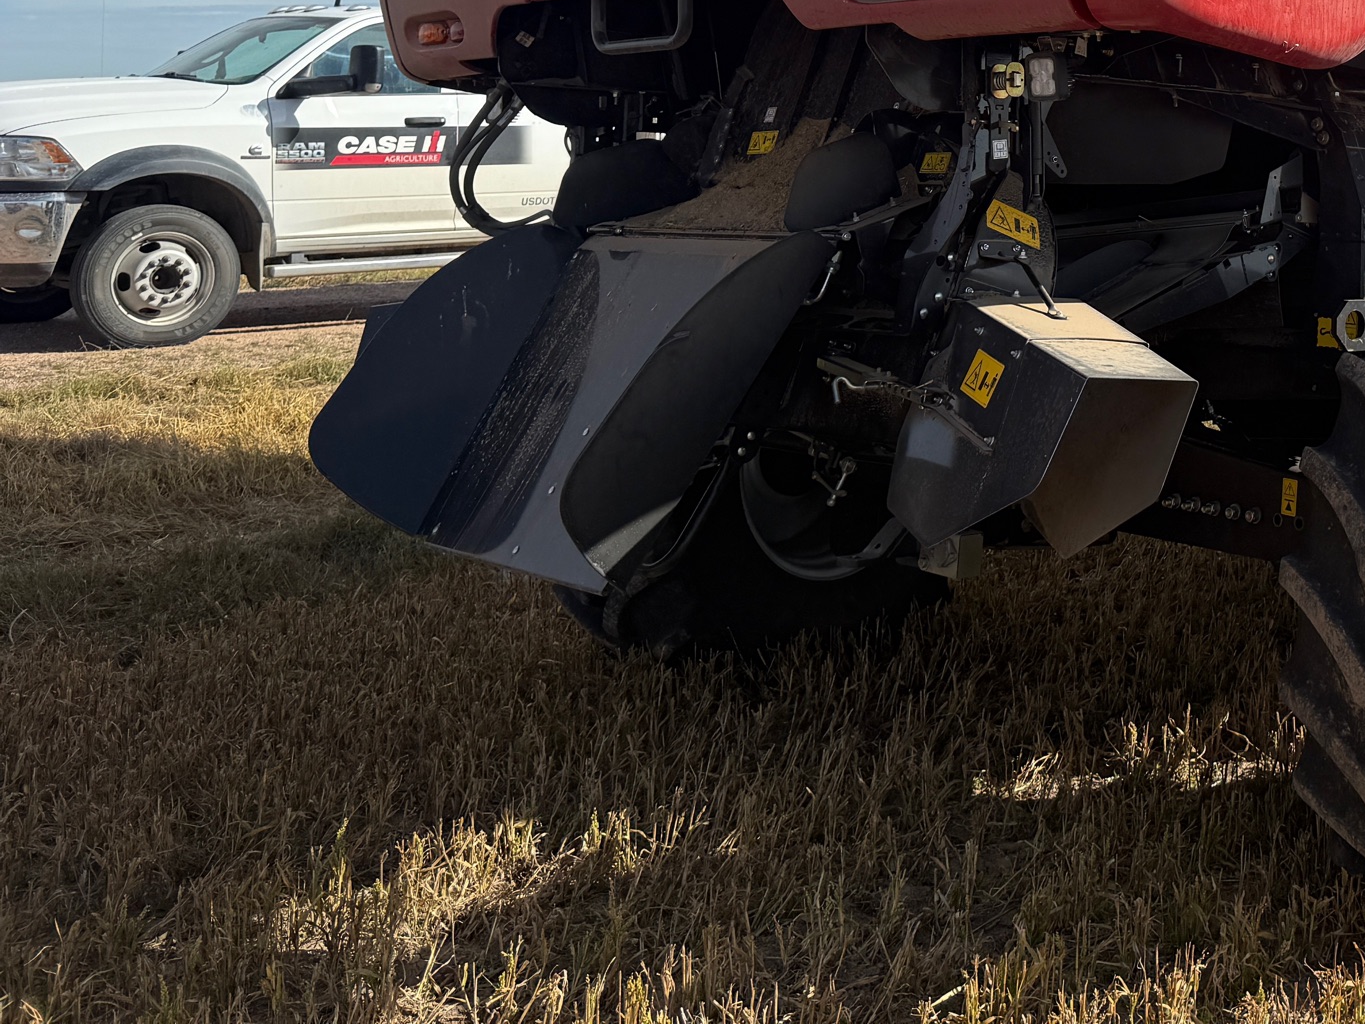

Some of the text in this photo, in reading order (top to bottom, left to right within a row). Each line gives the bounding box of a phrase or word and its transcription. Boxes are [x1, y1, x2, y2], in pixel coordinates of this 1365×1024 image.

[277, 141, 326, 150] RAM
[337, 135, 418, 154] CASE
[276, 149, 326, 158] 5500
[384, 154, 439, 164] AGRICULTURE
[521, 196, 556, 206] USDOT
